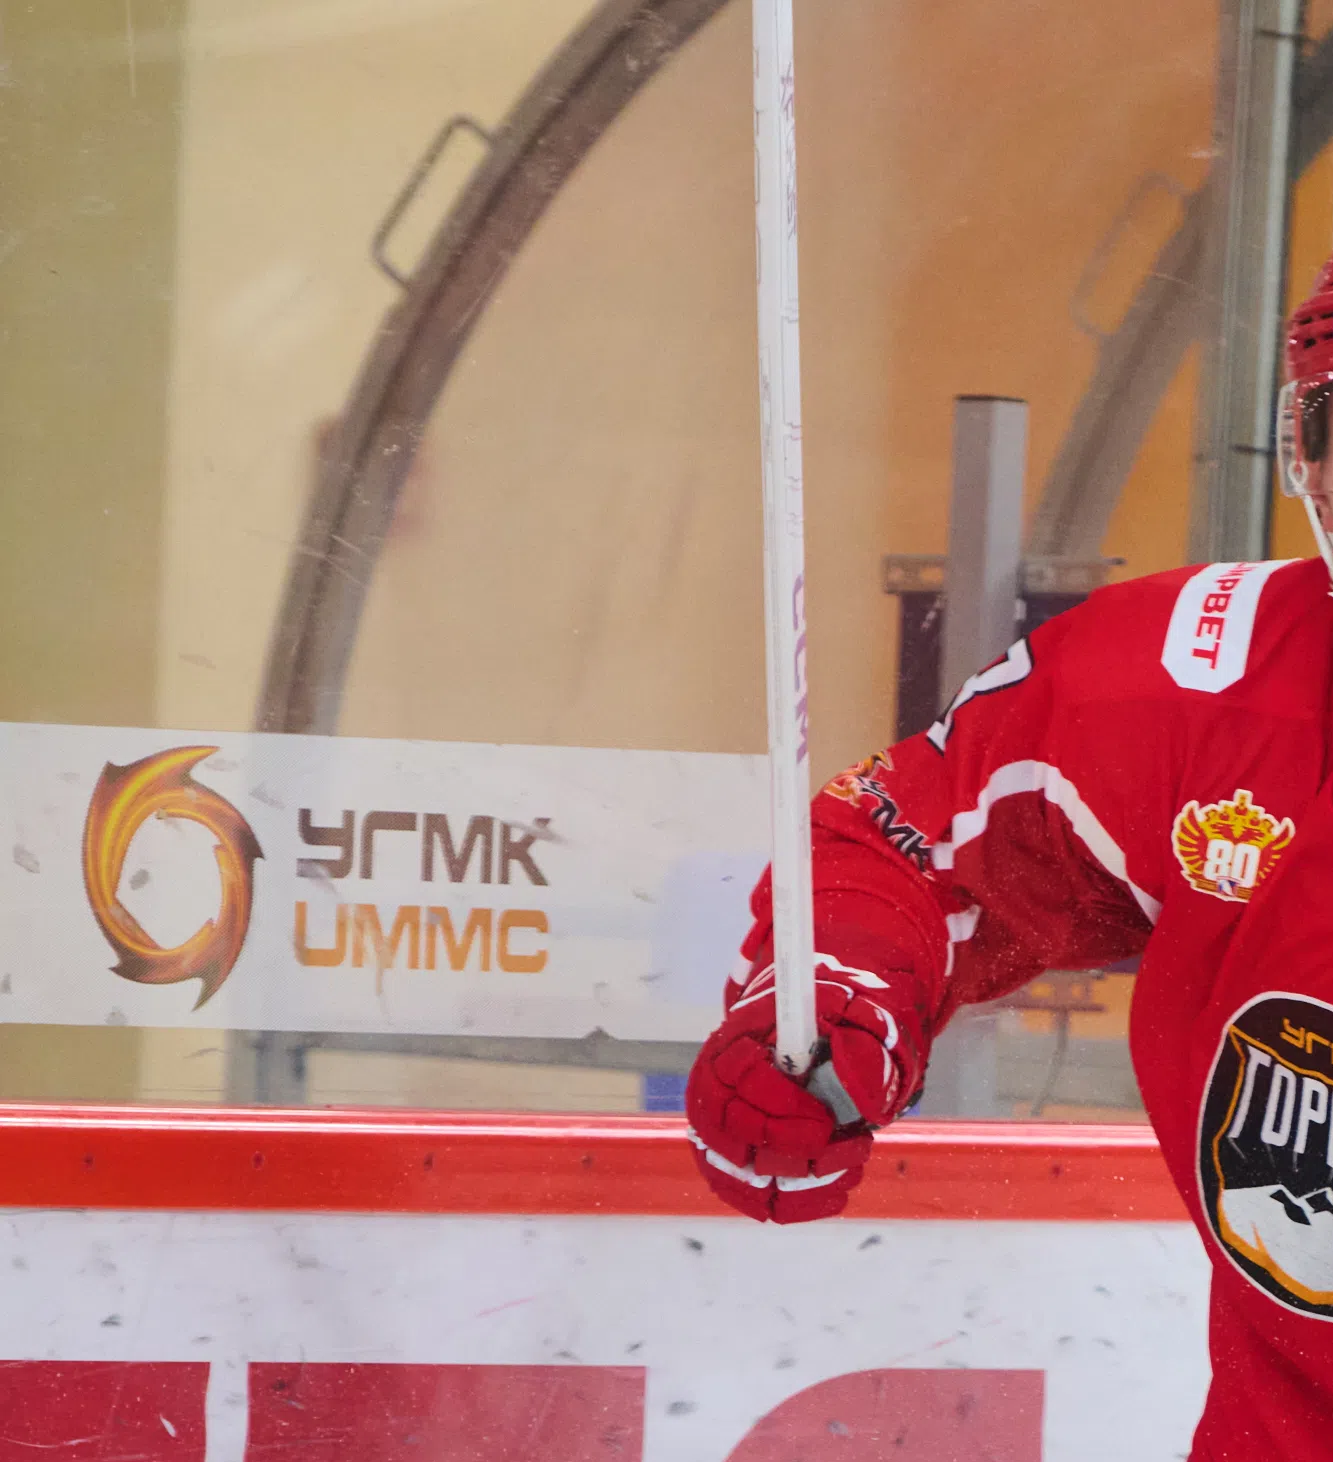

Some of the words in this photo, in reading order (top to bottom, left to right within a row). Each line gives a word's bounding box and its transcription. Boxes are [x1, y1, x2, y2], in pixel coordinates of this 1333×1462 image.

[1191, 561, 1257, 670] MPBET
[296, 807, 552, 886] УГМК
[1204, 839, 1261, 888] 80
[294, 900, 549, 973] UMMC
